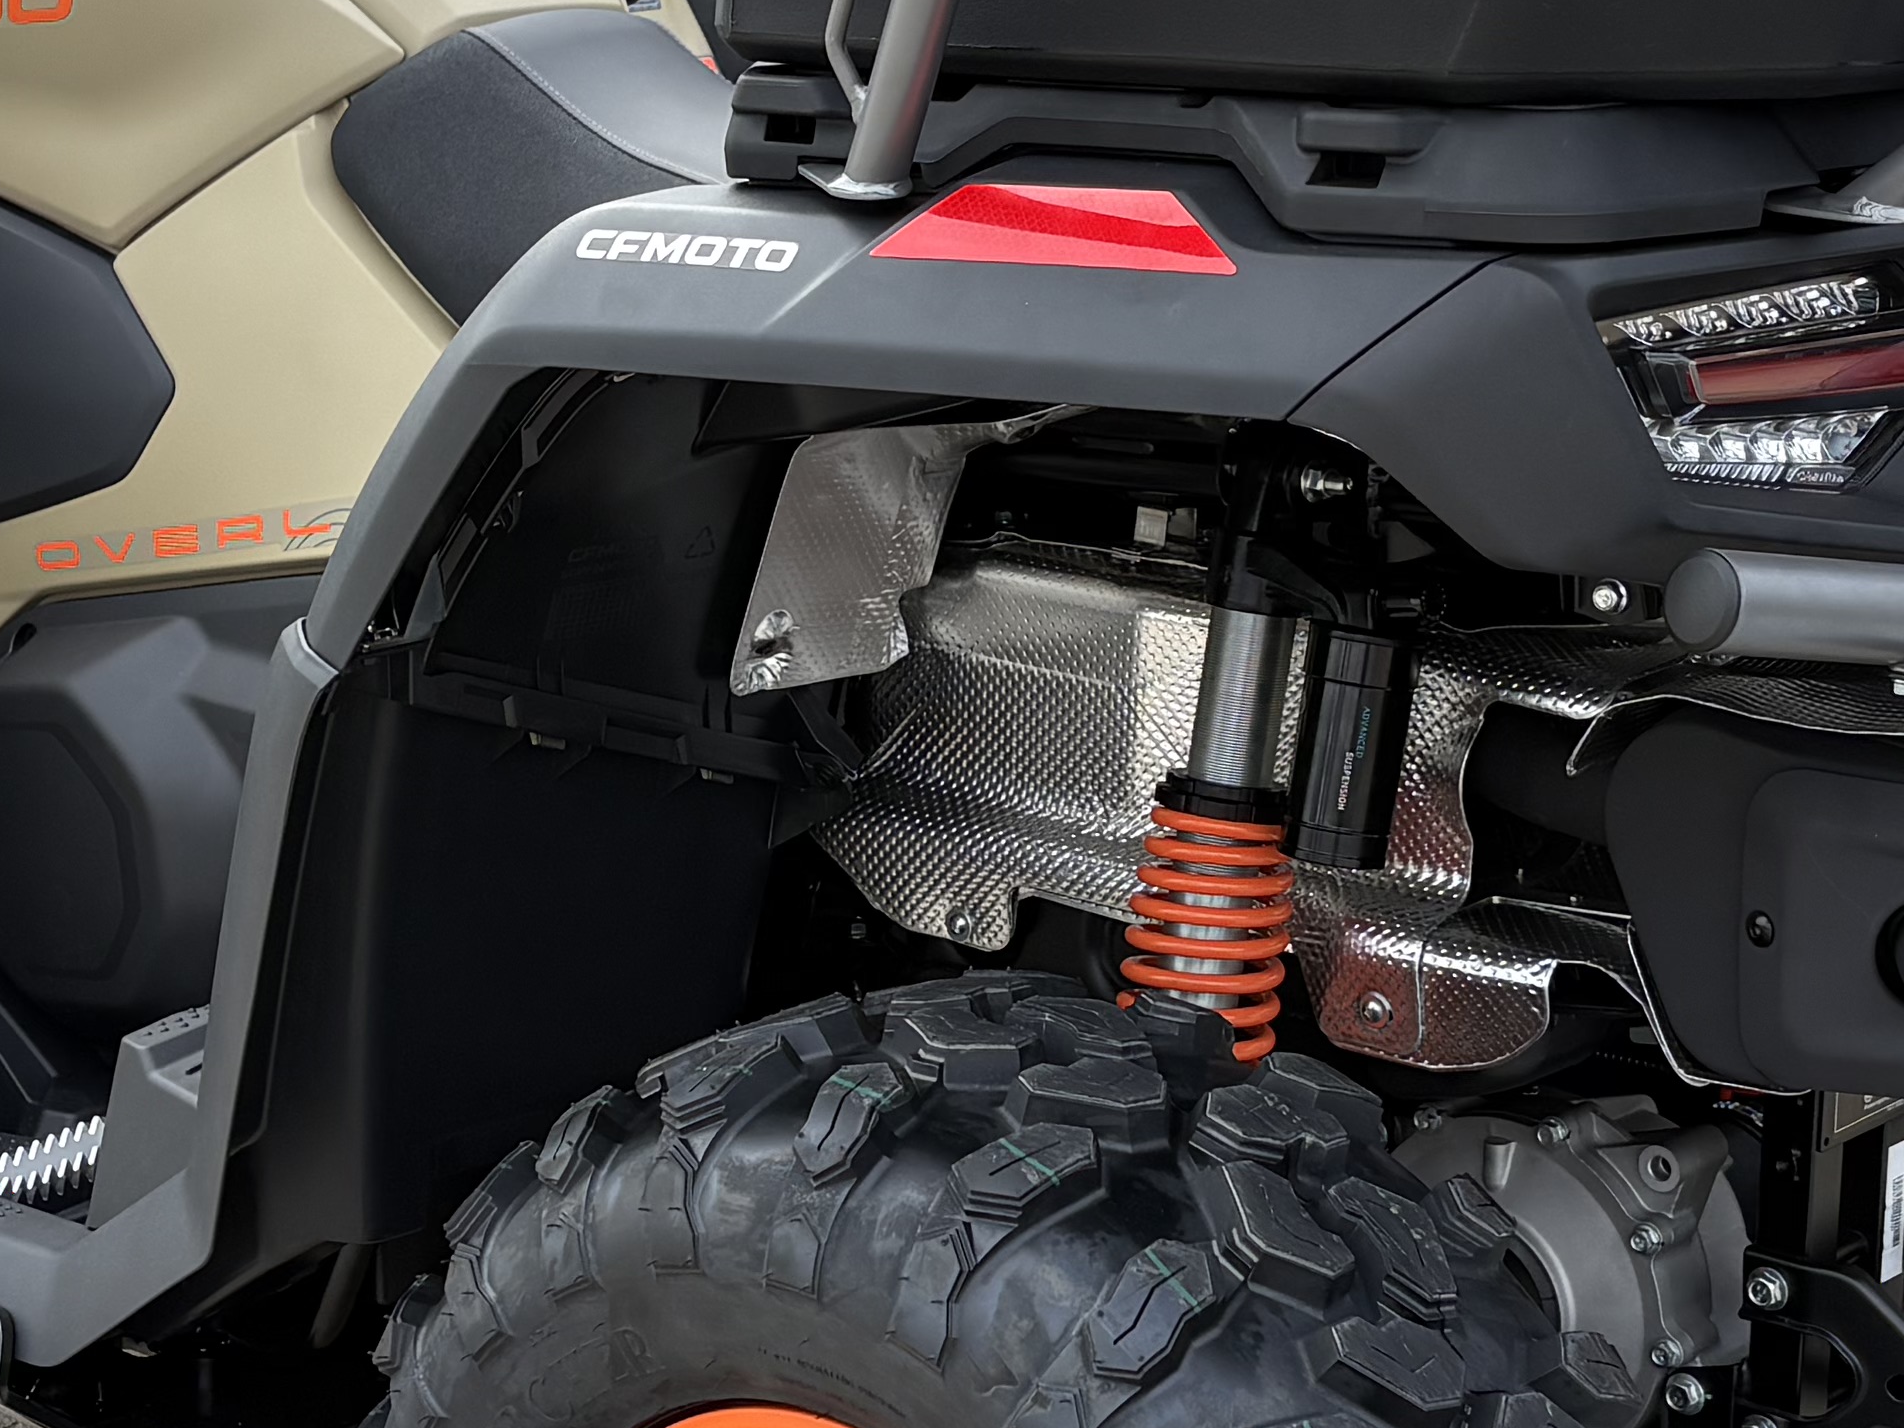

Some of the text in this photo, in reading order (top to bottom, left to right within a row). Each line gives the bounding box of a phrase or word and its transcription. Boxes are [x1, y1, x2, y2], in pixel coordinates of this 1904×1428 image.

[576, 229, 800, 272] CFMOTO
[1356, 706, 1371, 759] ADVANCED
[1337, 752, 1355, 811] SUSPENSION
